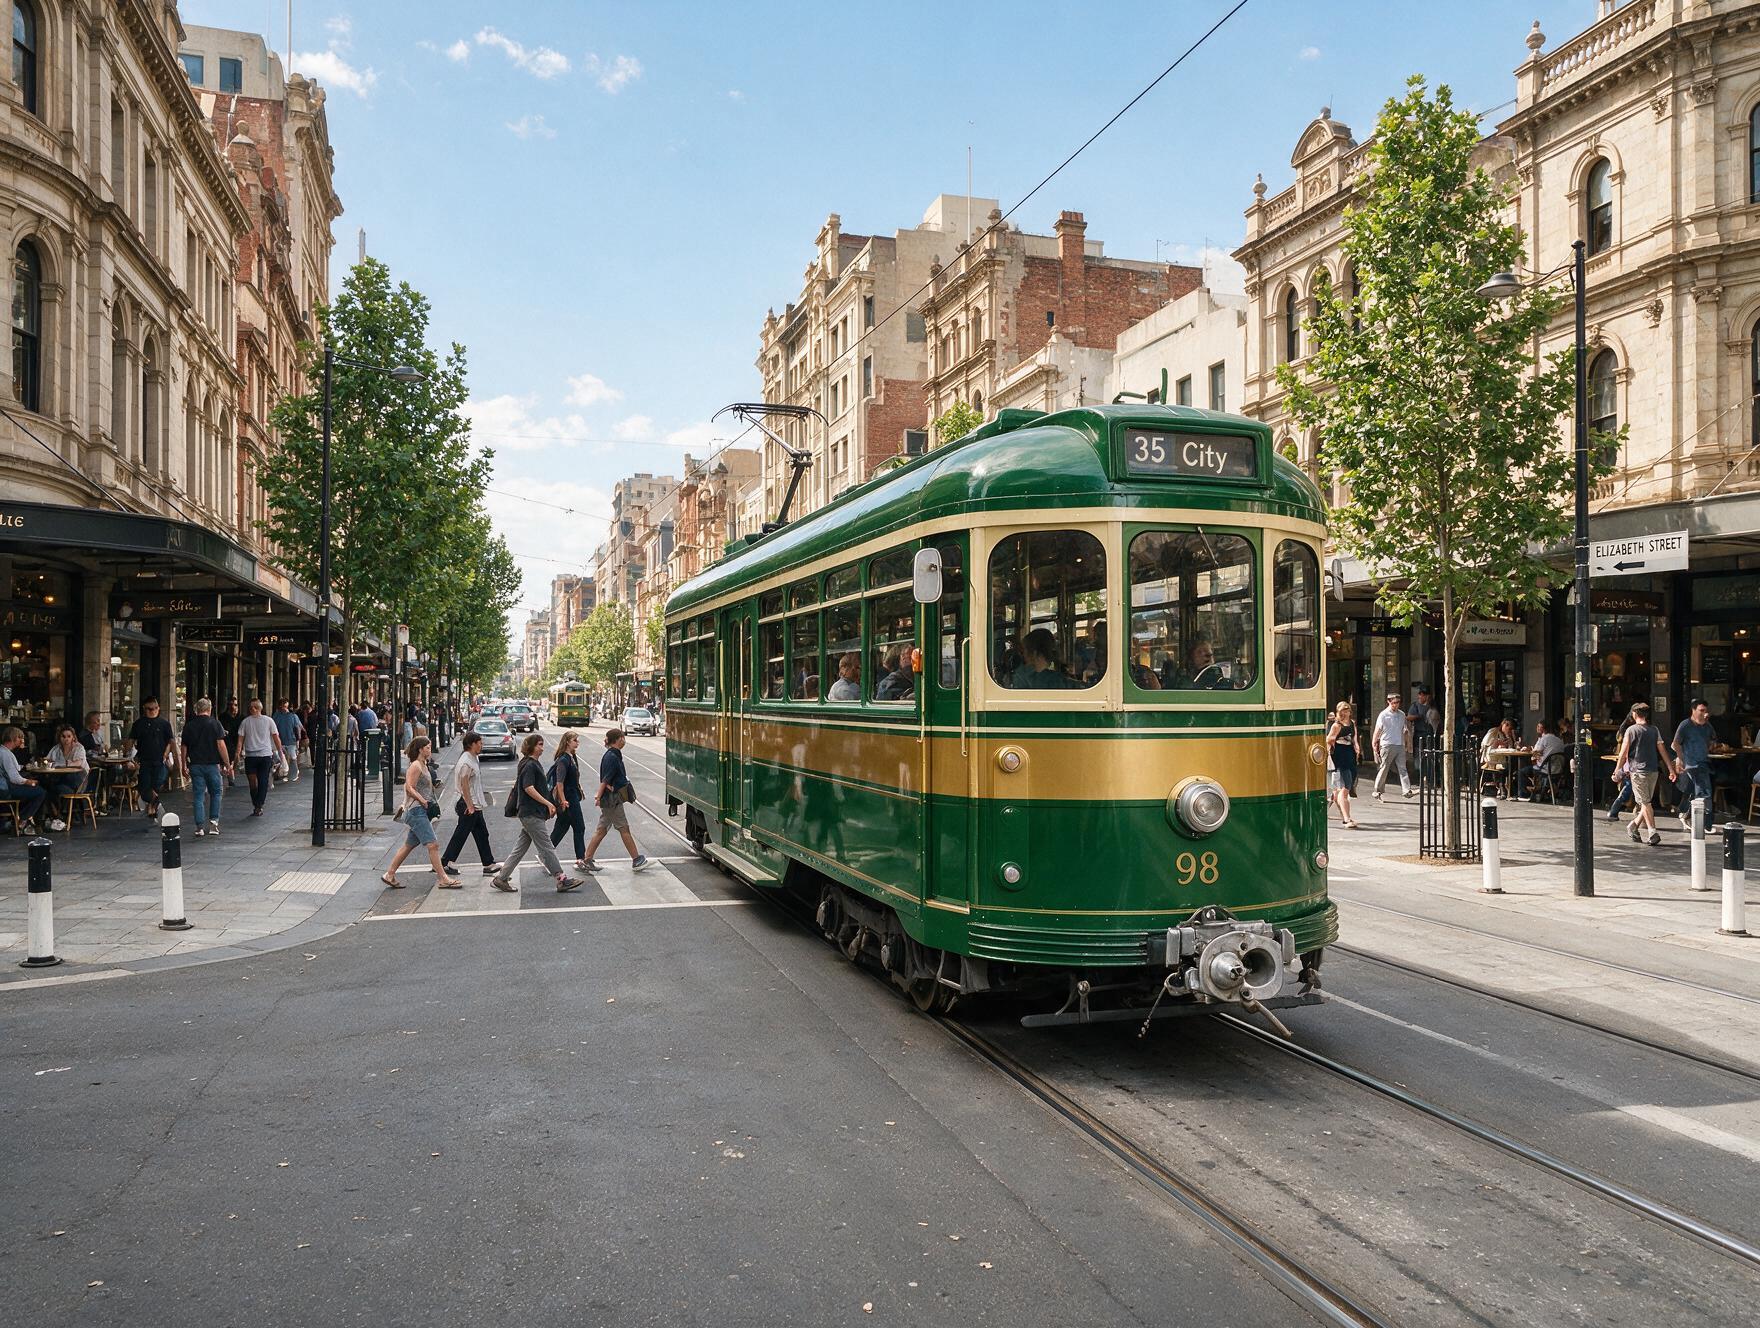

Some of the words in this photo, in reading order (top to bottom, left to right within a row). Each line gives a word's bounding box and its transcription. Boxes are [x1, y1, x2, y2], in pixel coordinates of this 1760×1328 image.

[1135, 436, 1165, 463] 35
[1182, 441, 1228, 474] City
[1596, 541, 1644, 558] ELIZABETH
[1649, 536, 1682, 552] STREET
[1176, 851, 1219, 884] 98
